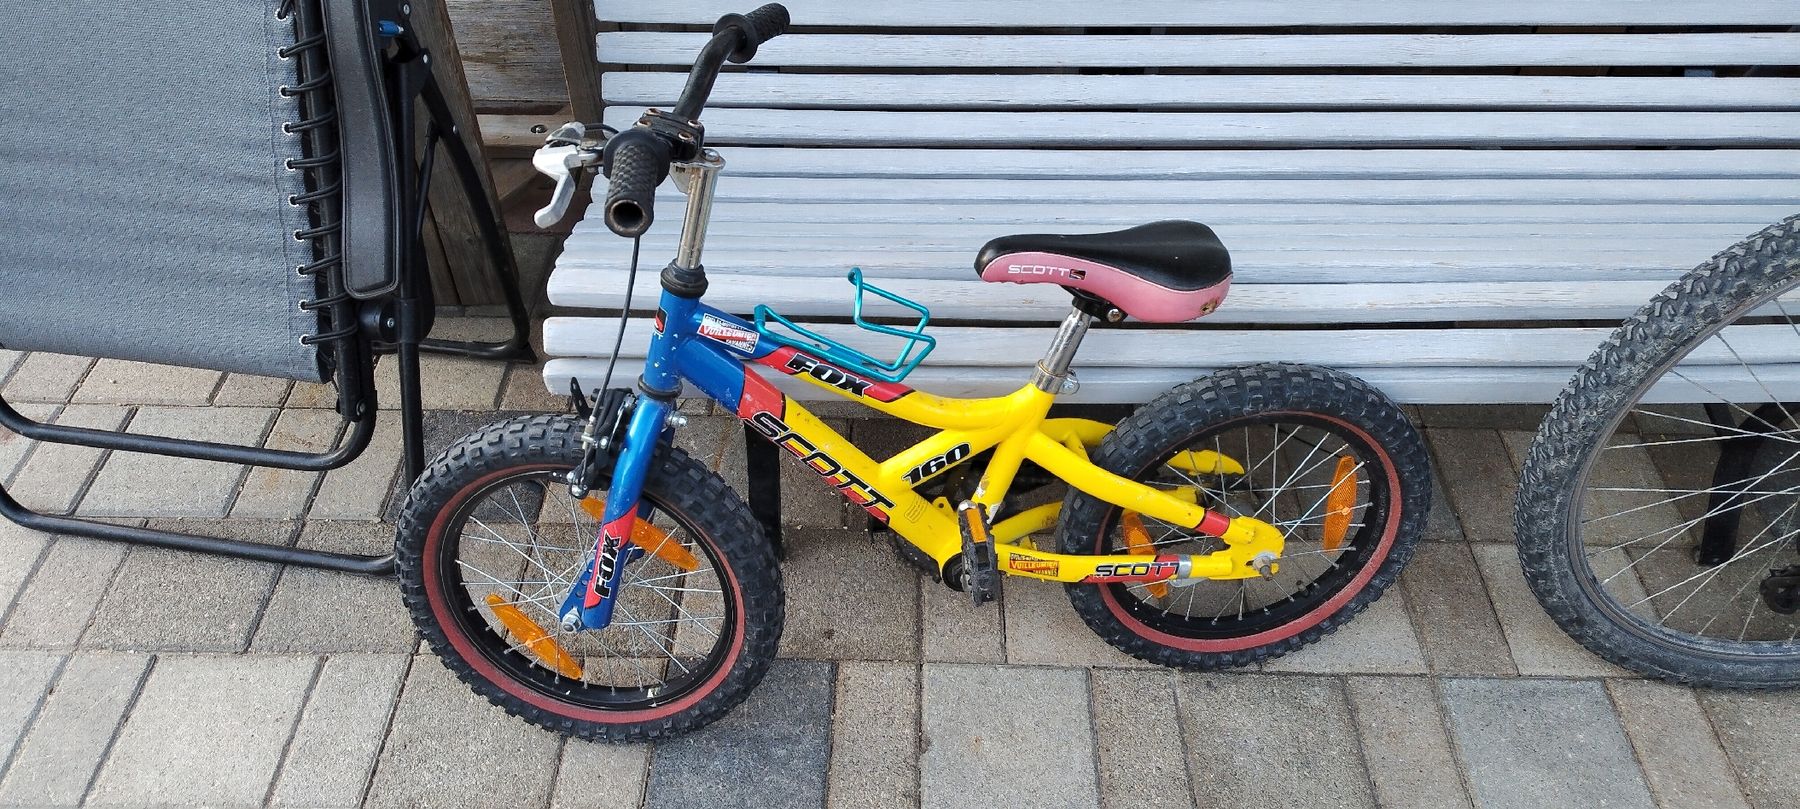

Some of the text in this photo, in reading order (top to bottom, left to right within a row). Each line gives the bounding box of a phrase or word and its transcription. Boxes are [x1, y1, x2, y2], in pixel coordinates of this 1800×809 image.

[1008, 264, 1070, 276] SCOTT
[785, 352, 874, 398] FOX
[749, 411, 896, 510] SCOTT
[901, 442, 971, 486] 160
[594, 529, 621, 598] FOX
